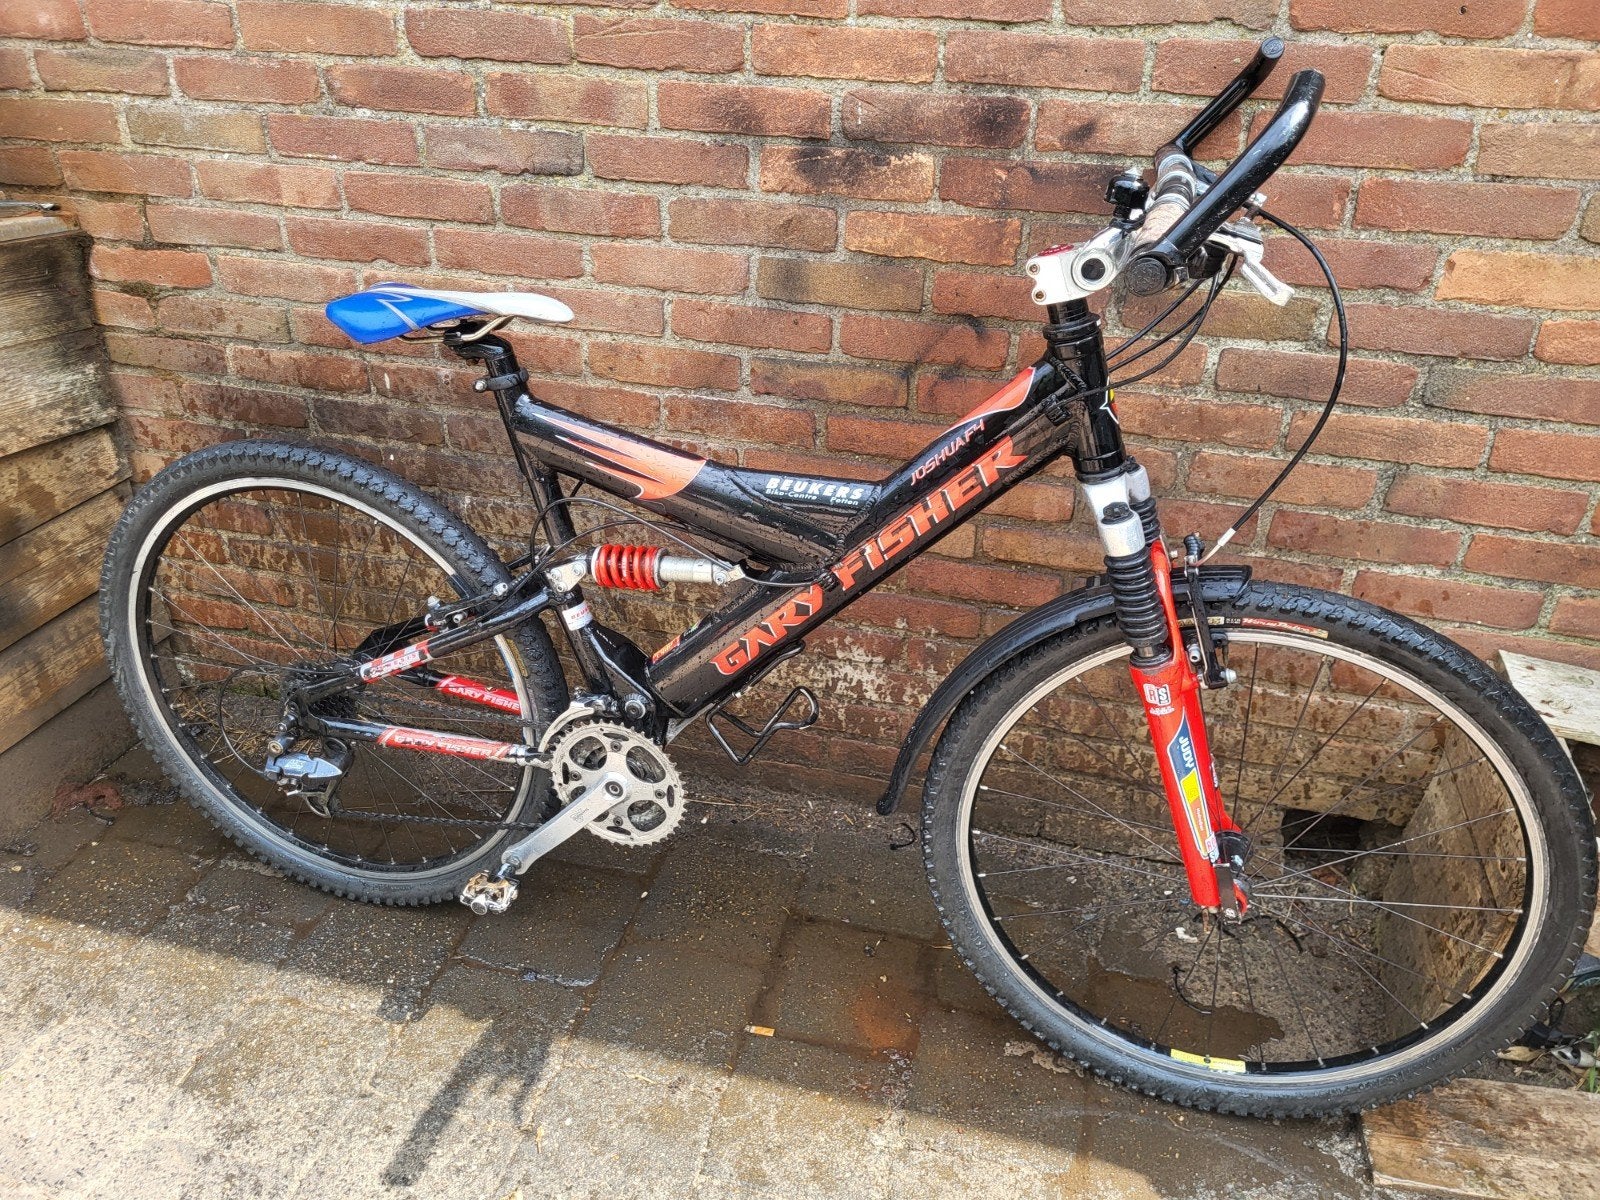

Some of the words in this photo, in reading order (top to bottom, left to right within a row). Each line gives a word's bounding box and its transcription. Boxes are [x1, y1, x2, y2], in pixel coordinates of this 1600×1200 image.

[765, 477, 865, 500] BEUKERS
[710, 582, 824, 676] GARY
[831, 435, 1028, 591] FISHER
[448, 683, 482, 702] GARY
[482, 693, 521, 711] FISHE
[1179, 736, 1195, 769] JUDY
